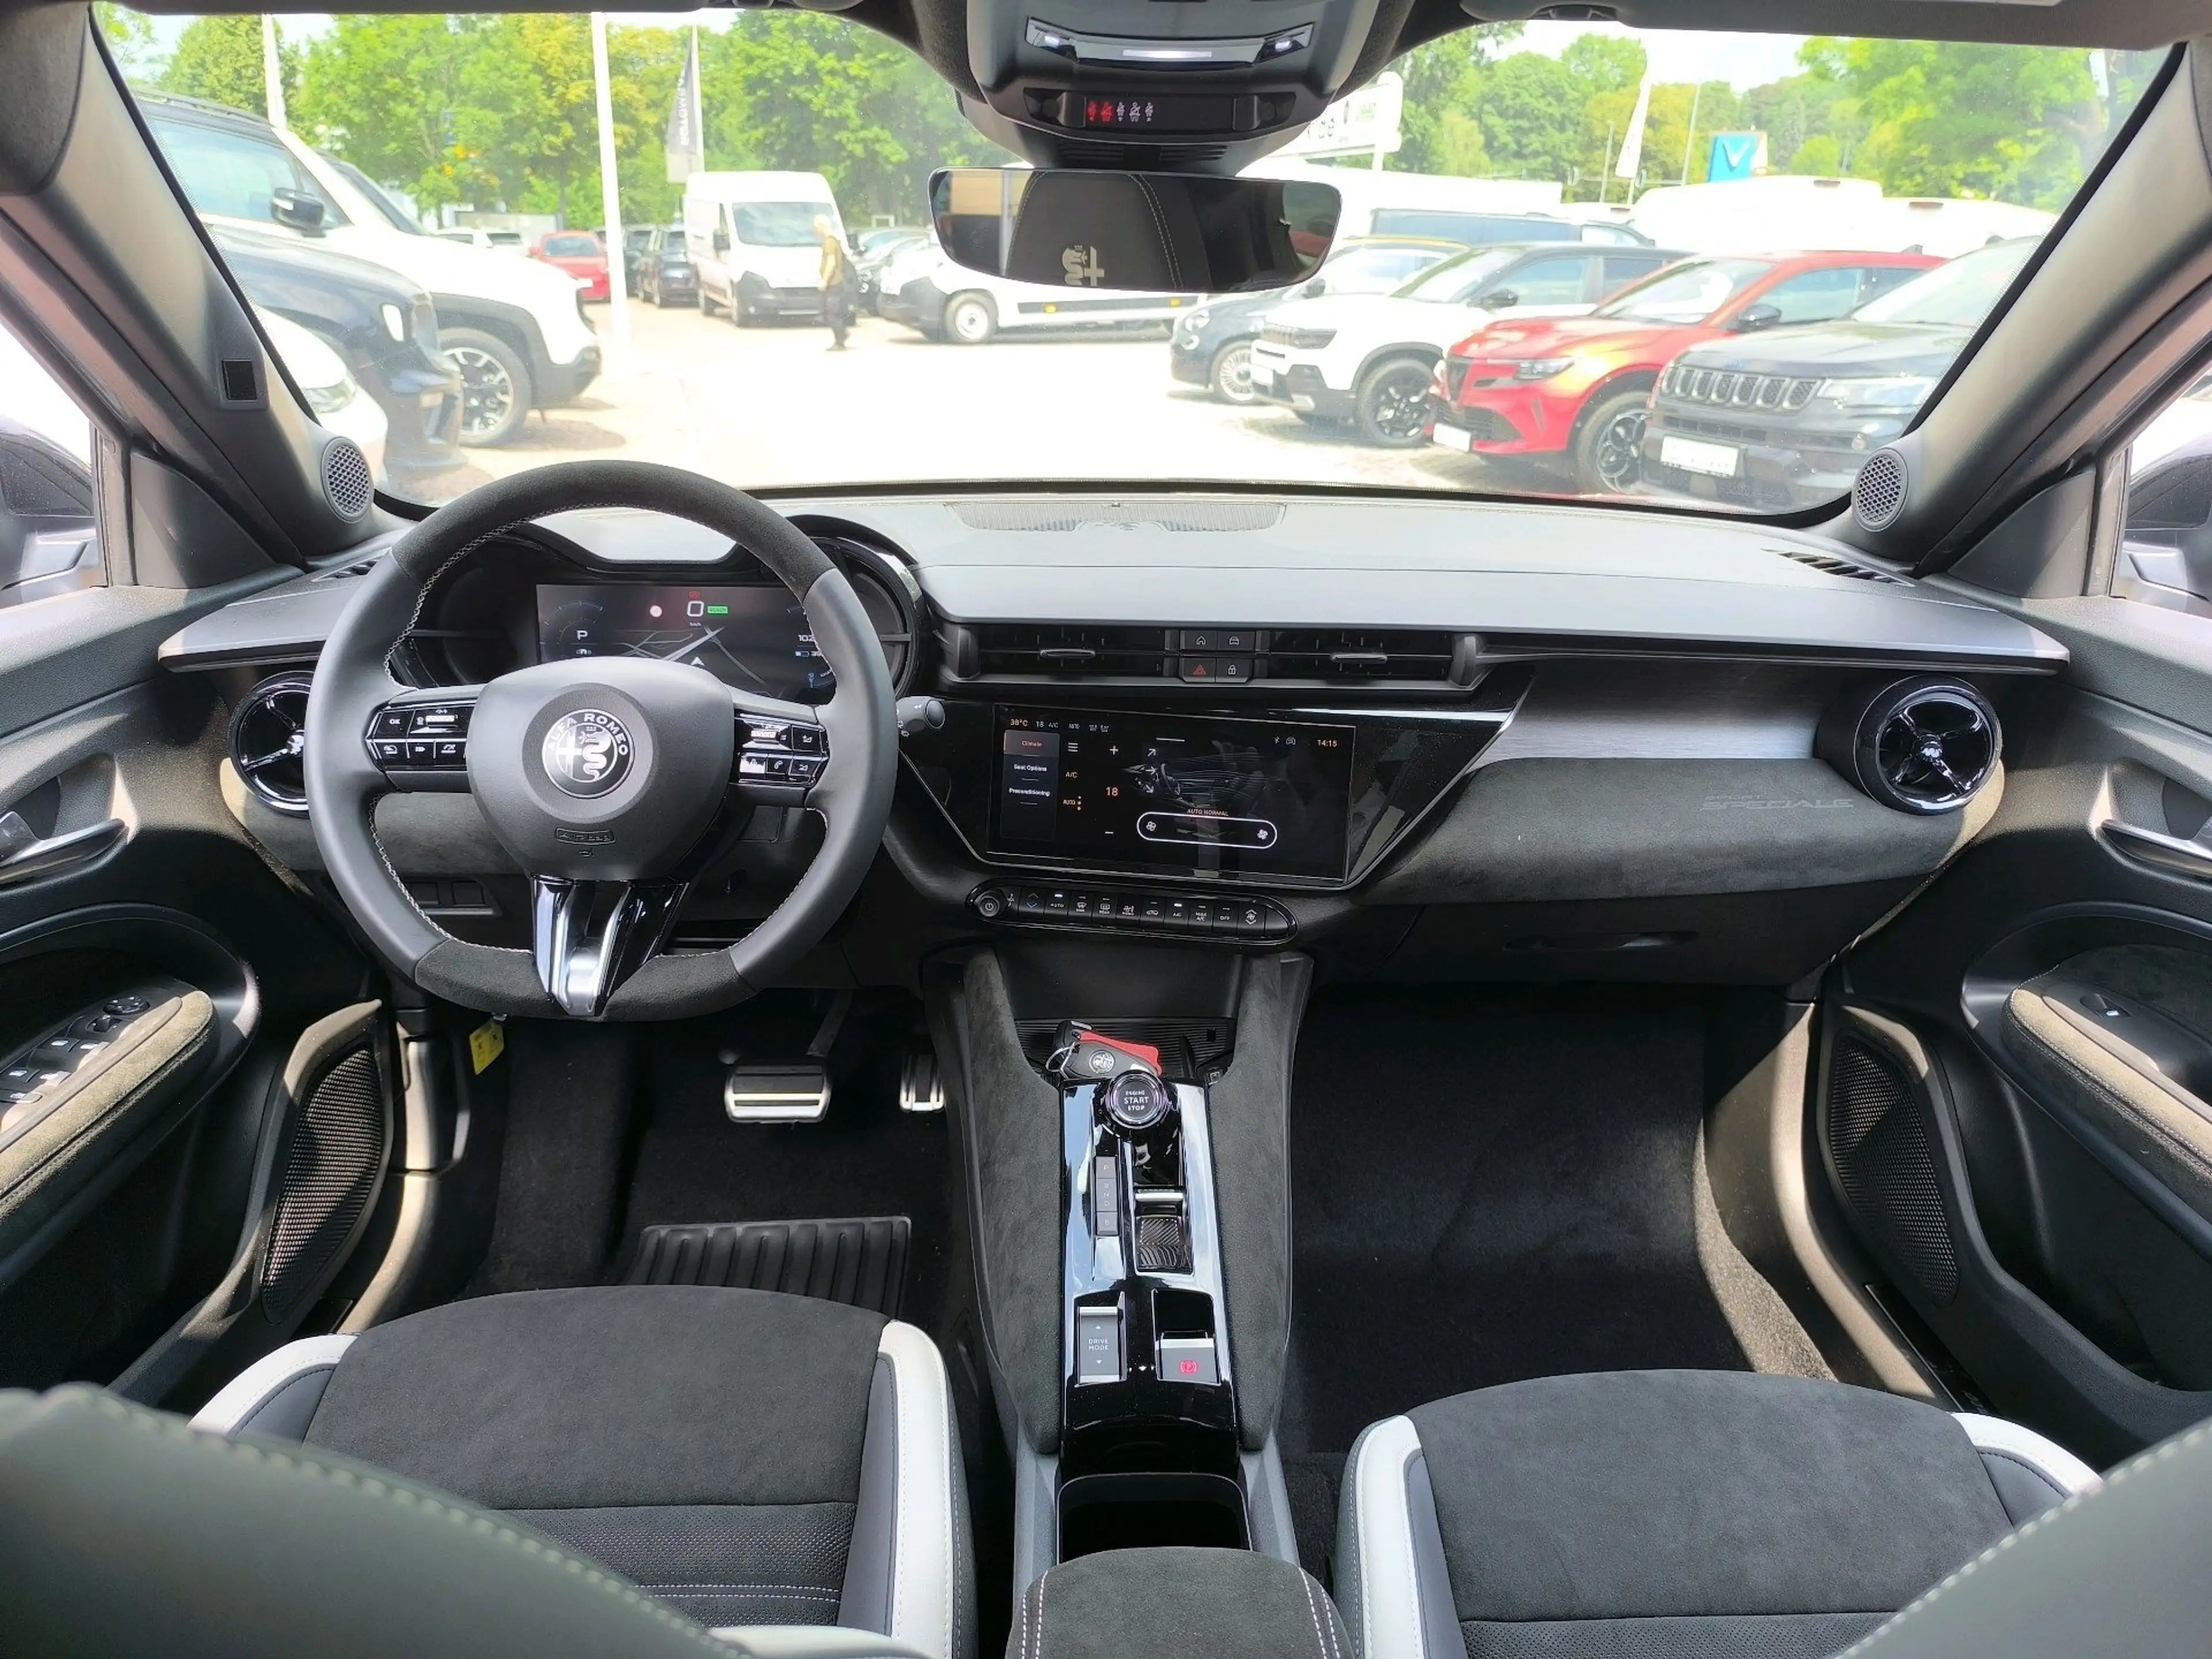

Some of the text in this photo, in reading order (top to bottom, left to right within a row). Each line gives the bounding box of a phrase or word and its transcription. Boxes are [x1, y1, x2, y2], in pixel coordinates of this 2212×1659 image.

[687, 601, 704, 617] 0
[577, 630, 588, 640] P
[584, 713, 629, 756] ROMEO
[1027, 764, 1047, 772] Options
[1009, 788, 1051, 797] Preconditioning
[1106, 787, 1119, 796] 18
[1700, 799, 1854, 810] SPECIALE
[1124, 1096, 1149, 1105] START
